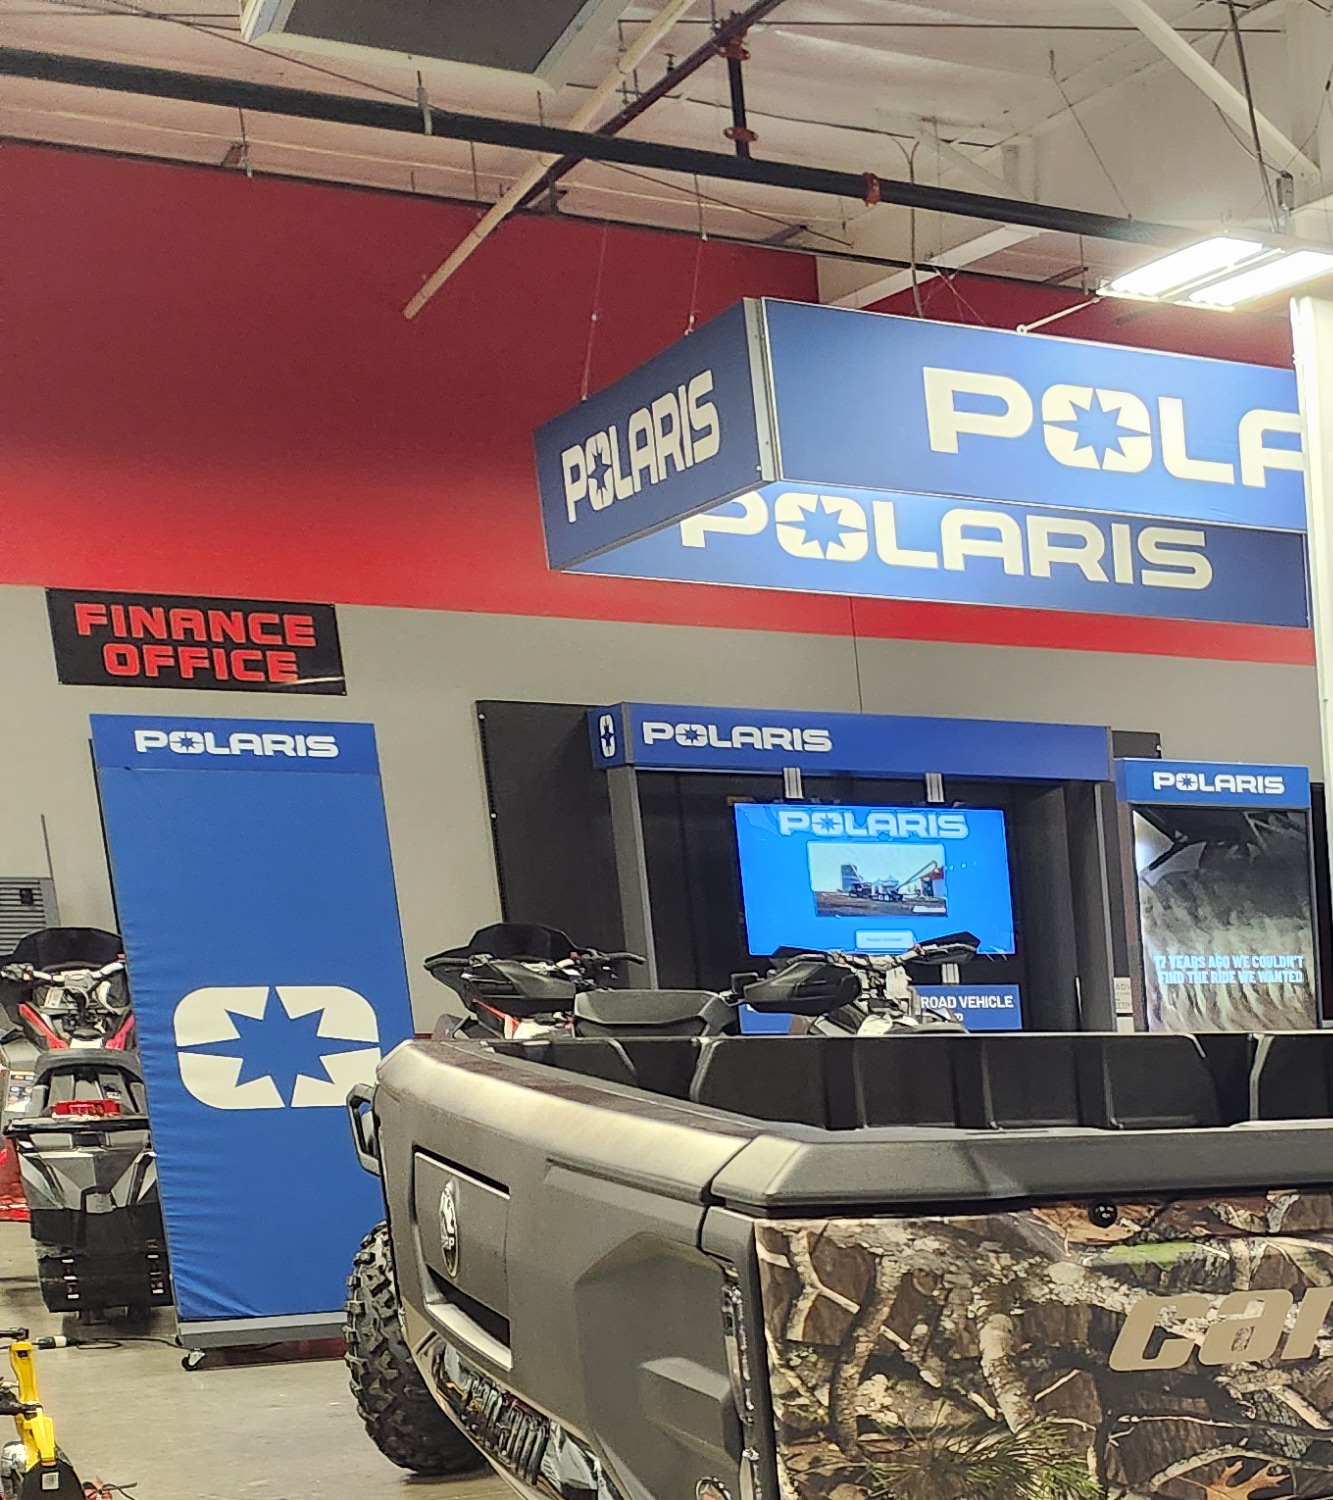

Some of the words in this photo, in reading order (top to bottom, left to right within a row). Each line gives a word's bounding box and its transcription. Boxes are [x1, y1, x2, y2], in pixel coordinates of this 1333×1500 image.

[561, 370, 720, 523] POLARIS
[679, 490, 1213, 590] POLARIS
[74, 602, 316, 647] FINANCE
[102, 643, 298, 683] OFFICE
[134, 729, 340, 758] POLARIS
[642, 721, 833, 752] POLARIS
[1153, 771, 1286, 794] POLARIS
[778, 810, 969, 838] POLARIS
[1169, 955, 1206, 968] YEARS
[1208, 955, 1230, 968] AGO
[1232, 955, 1250, 968] WE
[1252, 954, 1304, 968] COULDN'T
[1158, 970, 1184, 984] FIND
[1186, 970, 1208, 984] THE
[1210, 970, 1236, 984] RIDE
[1238, 970, 1256, 983] WE
[1258, 970, 1303, 983] WANTED
[958, 995, 1015, 1008] VEHICLE
